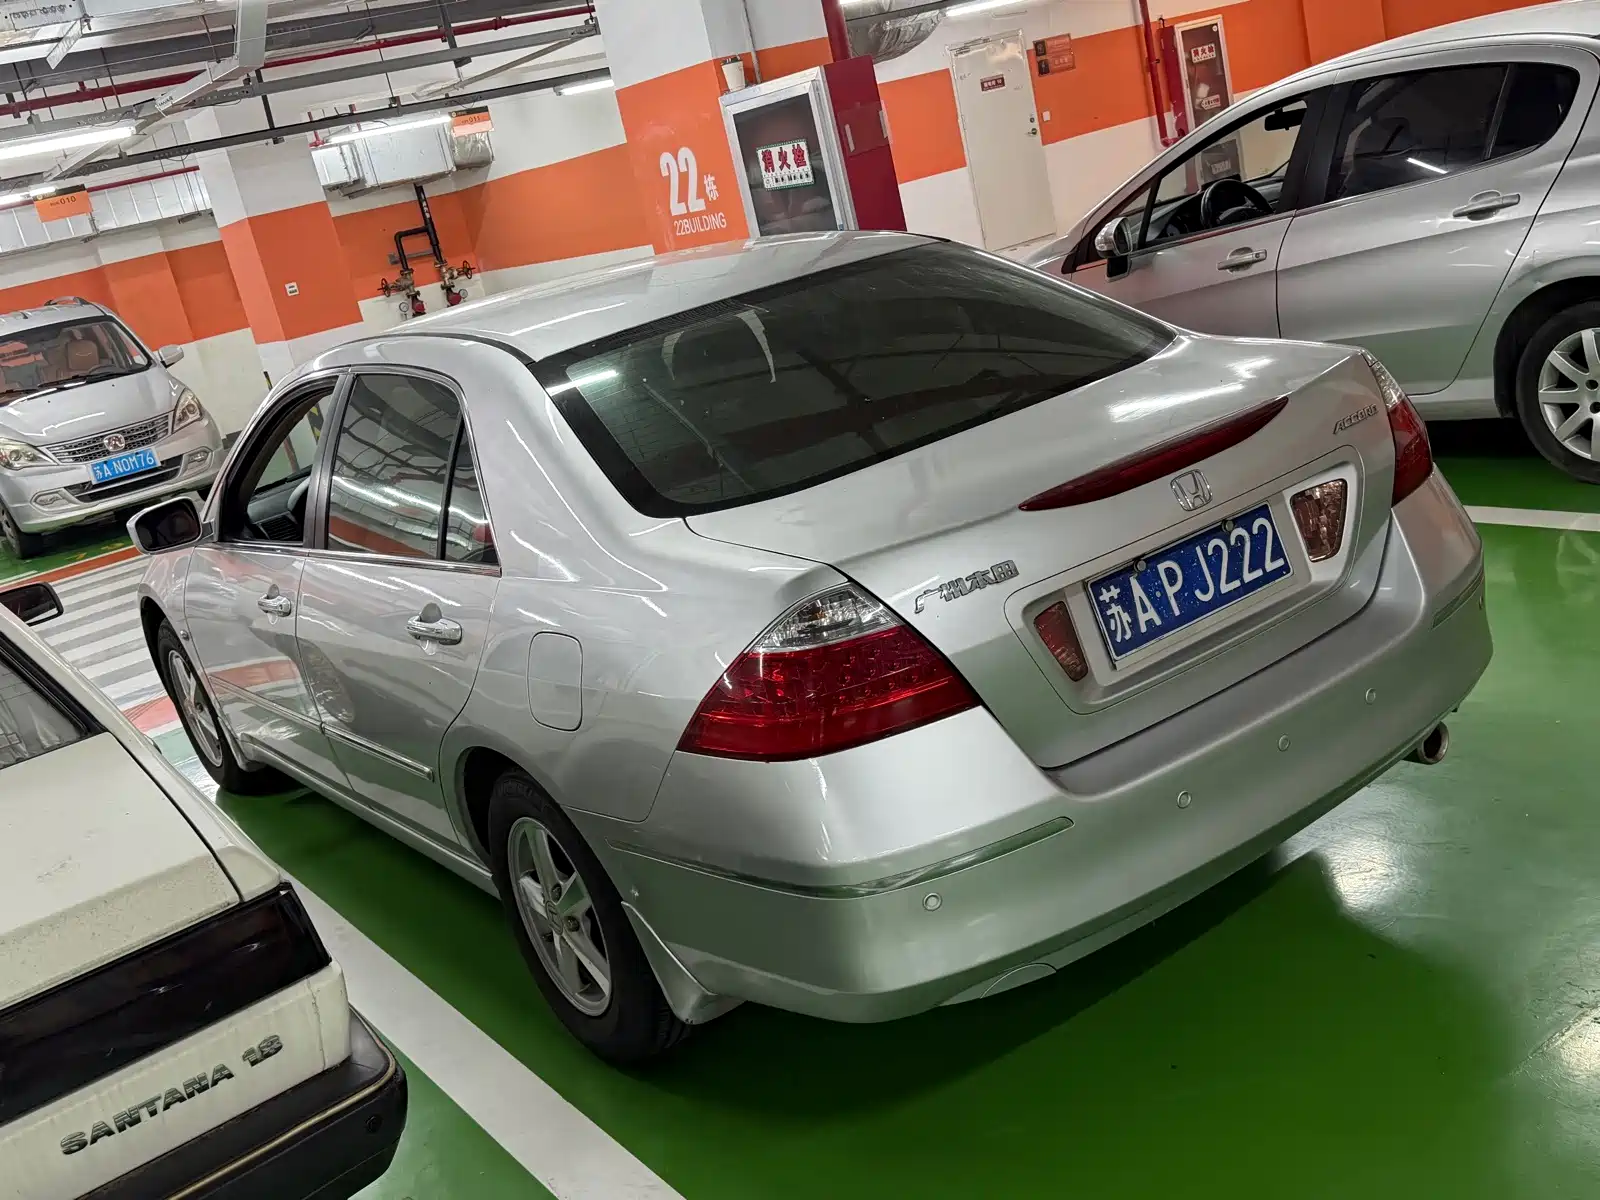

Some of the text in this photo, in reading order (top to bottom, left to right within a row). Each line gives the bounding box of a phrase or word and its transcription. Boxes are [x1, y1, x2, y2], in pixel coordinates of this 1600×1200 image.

[761, 143, 807, 173] 消火栓
[659, 146, 720, 217] 22 栋
[673, 211, 727, 236] 22BUILDING
[1333, 403, 1379, 435] ACCORD
[914, 559, 1020, 614] 广州本田
[59, 1063, 235, 1156] SANTANA
